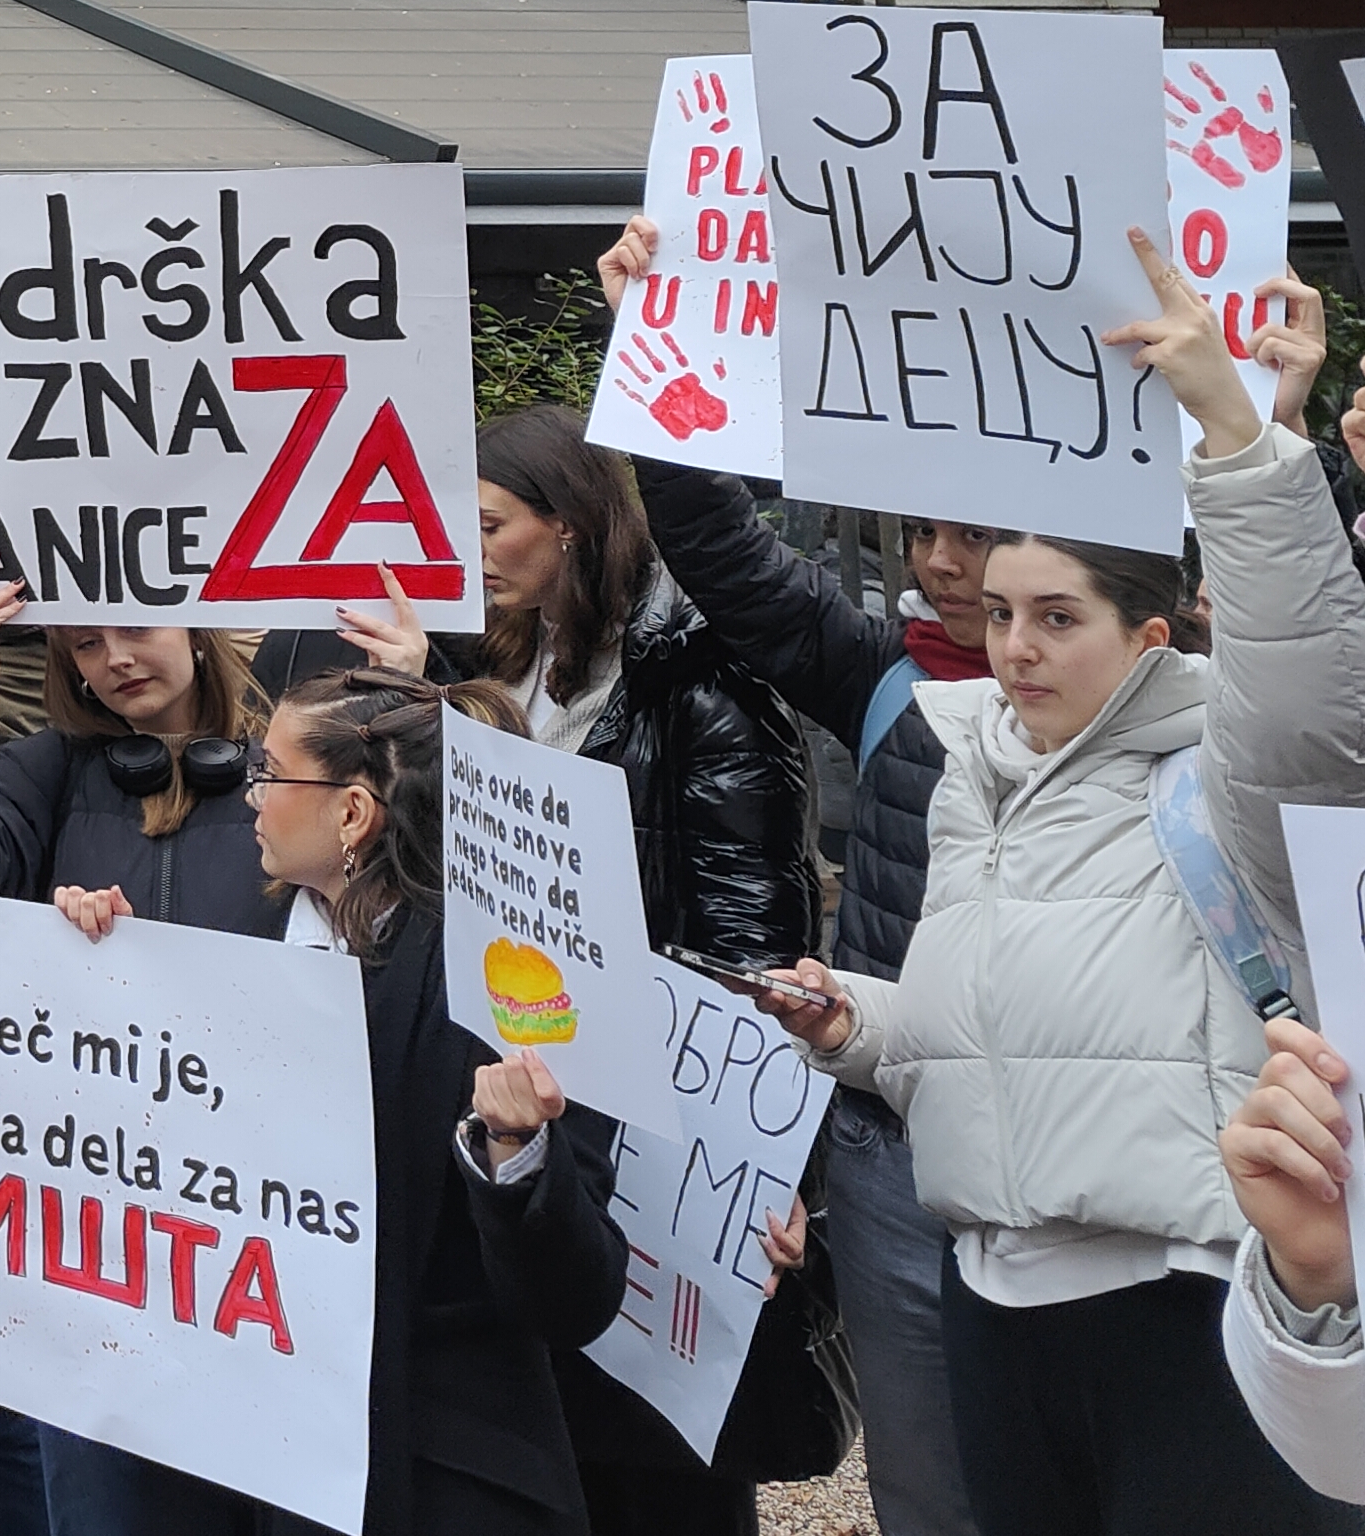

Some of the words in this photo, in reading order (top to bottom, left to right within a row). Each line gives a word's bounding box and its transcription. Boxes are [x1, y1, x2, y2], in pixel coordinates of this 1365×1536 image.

[812, 14, 1019, 165] ЗА
[3, 358, 248, 460] ZNA
[198, 353, 467, 602] ZA
[449, 788, 507, 845] pravimo
[513, 823, 583, 876] snove
[450, 745, 484, 798] Bolje
[488, 775, 535, 816] ovde
[541, 783, 571, 830] da
[447, 849, 496, 917] jedemo
[500, 900, 605, 970] sendviče
[453, 828, 487, 875] nego
[490, 846, 538, 900] tamo
[547, 876, 581, 918] da
[72, 1022, 140, 1083] mi
[151, 1030, 225, 1113] je,
[41, 1114, 163, 1192] dela
[177, 1157, 244, 1216] za
[260, 1175, 361, 1246] nas
